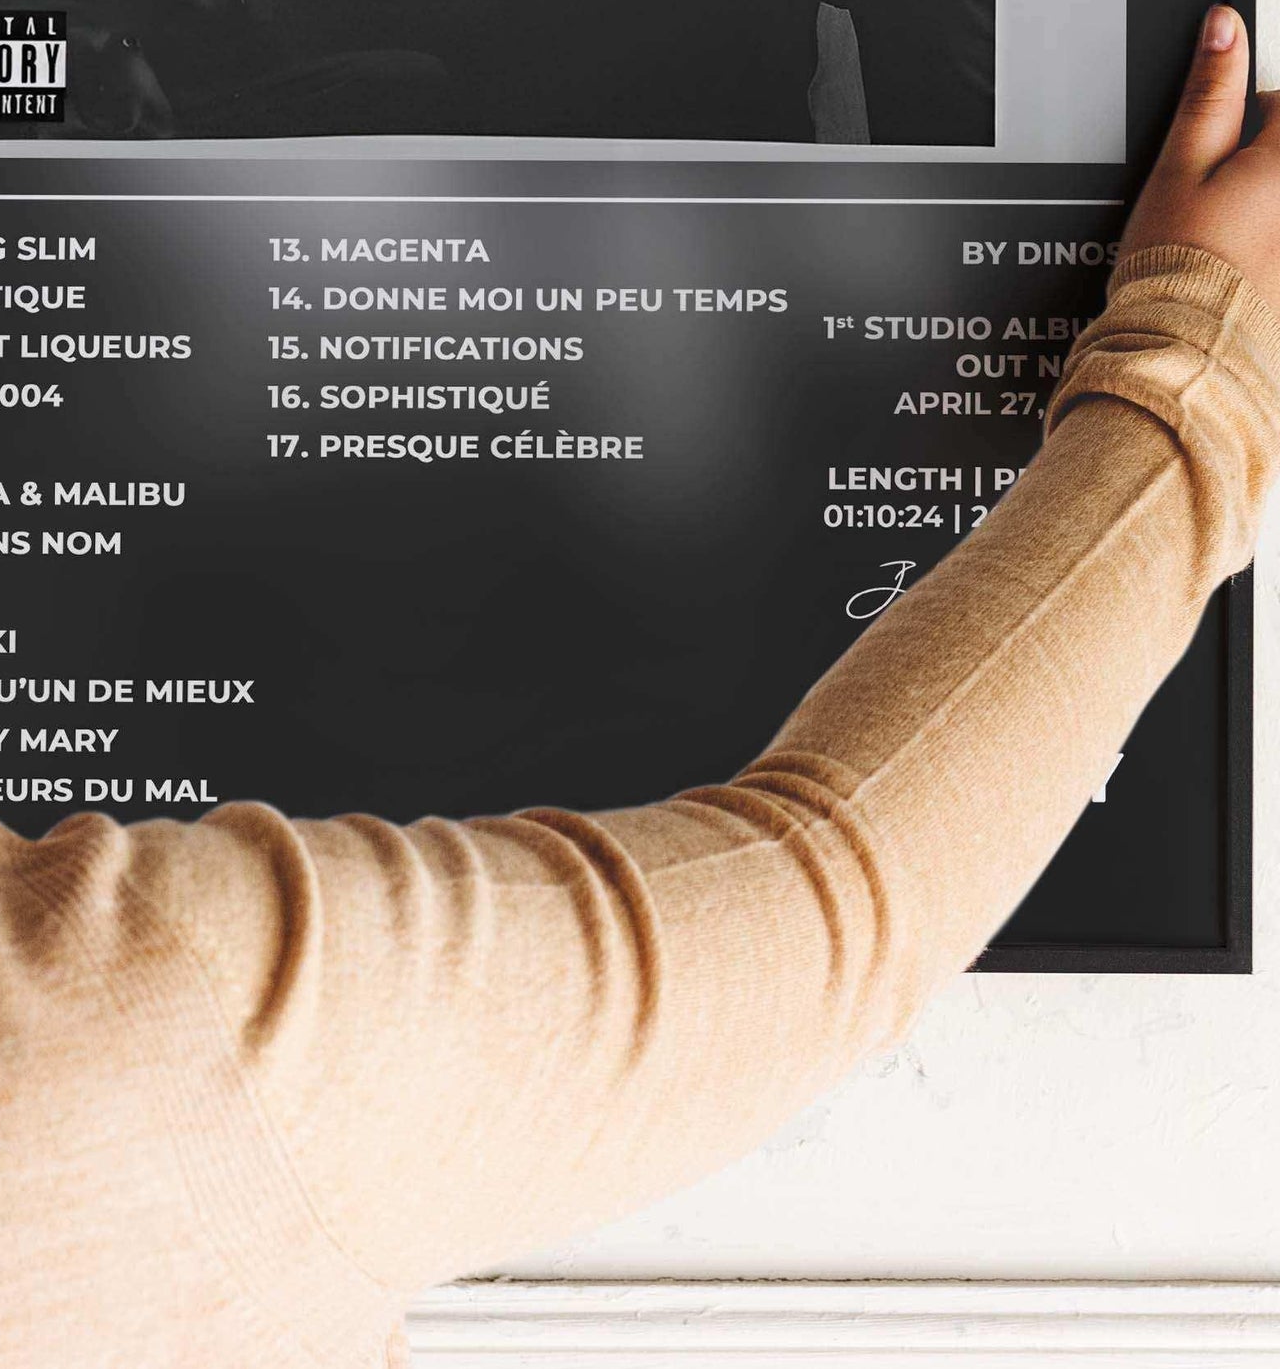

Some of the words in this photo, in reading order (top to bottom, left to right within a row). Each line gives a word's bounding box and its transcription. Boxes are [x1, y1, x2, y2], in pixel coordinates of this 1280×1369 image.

[16, 236, 96, 261] SLIM
[268, 238, 310, 263] 13.
[321, 237, 491, 263] MAGENTA
[962, 241, 1008, 266] BY
[1017, 241, 1121, 266] DINOS
[268, 286, 313, 311] 14.
[323, 286, 447, 311] DONNE
[458, 287, 523, 312] MOI
[535, 287, 583, 312] UN
[595, 288, 663, 312] PEU
[672, 288, 789, 313] TEMPS
[863, 316, 993, 341] STUDIO
[1001, 317, 1094, 341] ALBU
[20, 334, 192, 363] LIQUEURS
[267, 335, 309, 360] 15.
[319, 335, 584, 361] NOTIFICATIONS
[955, 353, 1028, 379] OUT
[266, 384, 310, 410] 16.
[319, 380, 550, 415] SOPHISTIQUÉ
[893, 391, 992, 416] APRIL
[999, 391, 1045, 420] 27,
[266, 434, 309, 459] 17.
[320, 434, 480, 464] PRESQUE
[490, 429, 644, 460] CÉLÈBRE
[828, 466, 963, 492] LENGTH
[19, 481, 43, 507] &
[54, 481, 186, 507] MALIBU
[823, 504, 945, 529] 01:10:24
[41, 531, 122, 556] NOM
[88, 679, 134, 703] DE
[145, 679, 255, 704] MIEUX
[20, 728, 120, 753] MARY
[84, 778, 134, 803] DU
[145, 778, 218, 803] MAL
